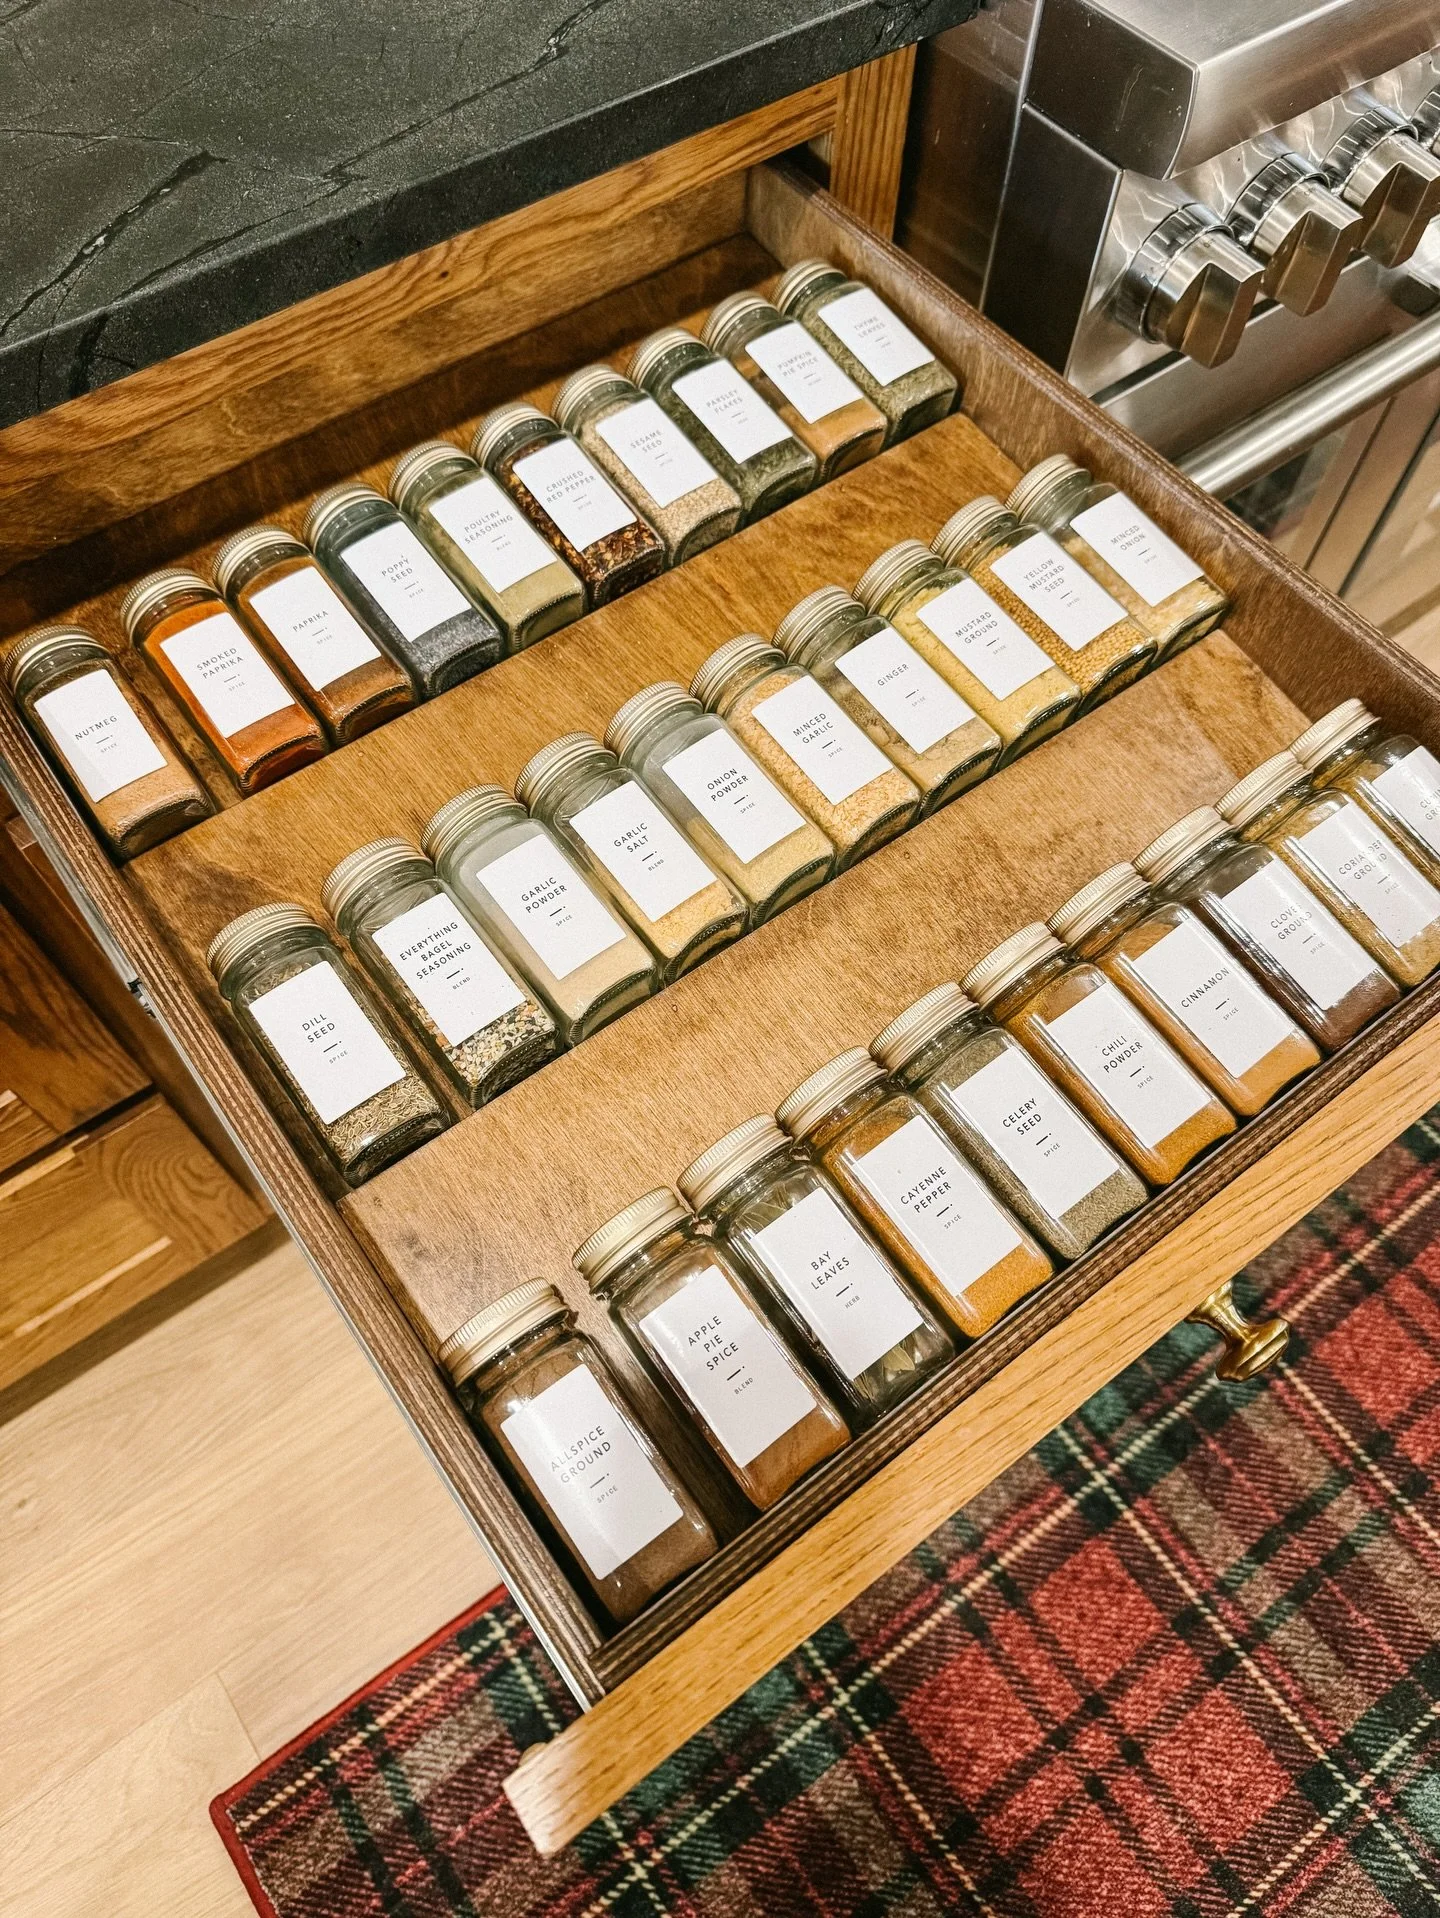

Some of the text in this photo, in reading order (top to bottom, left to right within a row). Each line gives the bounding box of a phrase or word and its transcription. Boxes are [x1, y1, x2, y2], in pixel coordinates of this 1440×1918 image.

[706, 389, 738, 407] PARSLEY
[630, 429, 662, 449] SESAME
[643, 439, 663, 453] SEED
[546, 470, 584, 492] CRUSHED
[546, 475, 595, 503] RED PEPPER
[464, 510, 501, 532] POULTRY
[464, 514, 514, 544] SEASONING
[1111, 525, 1140, 545] MINCED
[1120, 533, 1146, 550] ONION
[381, 558, 410, 576] POPPY
[390, 567, 413, 583] SEED
[1023, 559, 1054, 581] YELLOW
[1029, 565, 1065, 590] MUSTARD
[1045, 577, 1065, 592] SEED
[292, 610, 329, 632] PAPRIKA
[955, 611, 992, 637] MUSTARD
[964, 620, 998, 644] GROUND
[196, 647, 238, 670] SMOKED
[202, 656, 244, 679] PAPRIKA
[877, 663, 909, 686] GINGER
[75, 715, 118, 740] NUTMEG
[793, 713, 827, 737] MINCED
[802, 721, 834, 744] GARLIC
[707, 768, 738, 790] ONION
[711, 774, 749, 801] POWDER
[1420, 788, 1440, 809] CUI
[613, 822, 648, 847] GARLIC
[627, 835, 649, 852] SALT
[1338, 840, 1382, 875] CORIADER
[521, 877, 557, 902] GARLIC
[526, 884, 567, 913] POWDER
[400, 922, 458, 960] EVERYTHING
[420, 940, 453, 961] BAGEL
[1310, 941, 1326, 954] SPICE
[416, 942, 471, 979] SEASONING
[452, 976, 471, 989] BLEND
[1181, 968, 1230, 1008] CINNAMON
[302, 1014, 327, 1031] DILL
[1223, 1008, 1239, 1021] SPICE
[307, 1022, 335, 1043] SEED
[329, 1050, 348, 1064] SPICE
[1102, 1035, 1127, 1057] CHILI
[1103, 1041, 1143, 1073] POWDER
[1137, 1076, 1154, 1089] SPICE
[1002, 1098, 1038, 1128] CELERY
[1017, 1113, 1042, 1135] SEED
[1044, 1143, 1061, 1157] SPICE
[901, 1167, 947, 1205] CAYENNE
[914, 1181, 951, 1213] PEPPER
[944, 1214, 962, 1229] SPICE
[811, 1251, 831, 1271] BAY
[811, 1257, 850, 1290] LEAVES
[845, 1296, 861, 1309] HERB
[688, 1315, 721, 1346] APPLE
[704, 1334, 723, 1353] PIE
[706, 1342, 739, 1370] SPICE
[734, 1377, 753, 1394] BLEND
[551, 1426, 605, 1471] ALLSPICE
[560, 1442, 611, 1483] GROUND
[597, 1486, 618, 1503] SPICE
